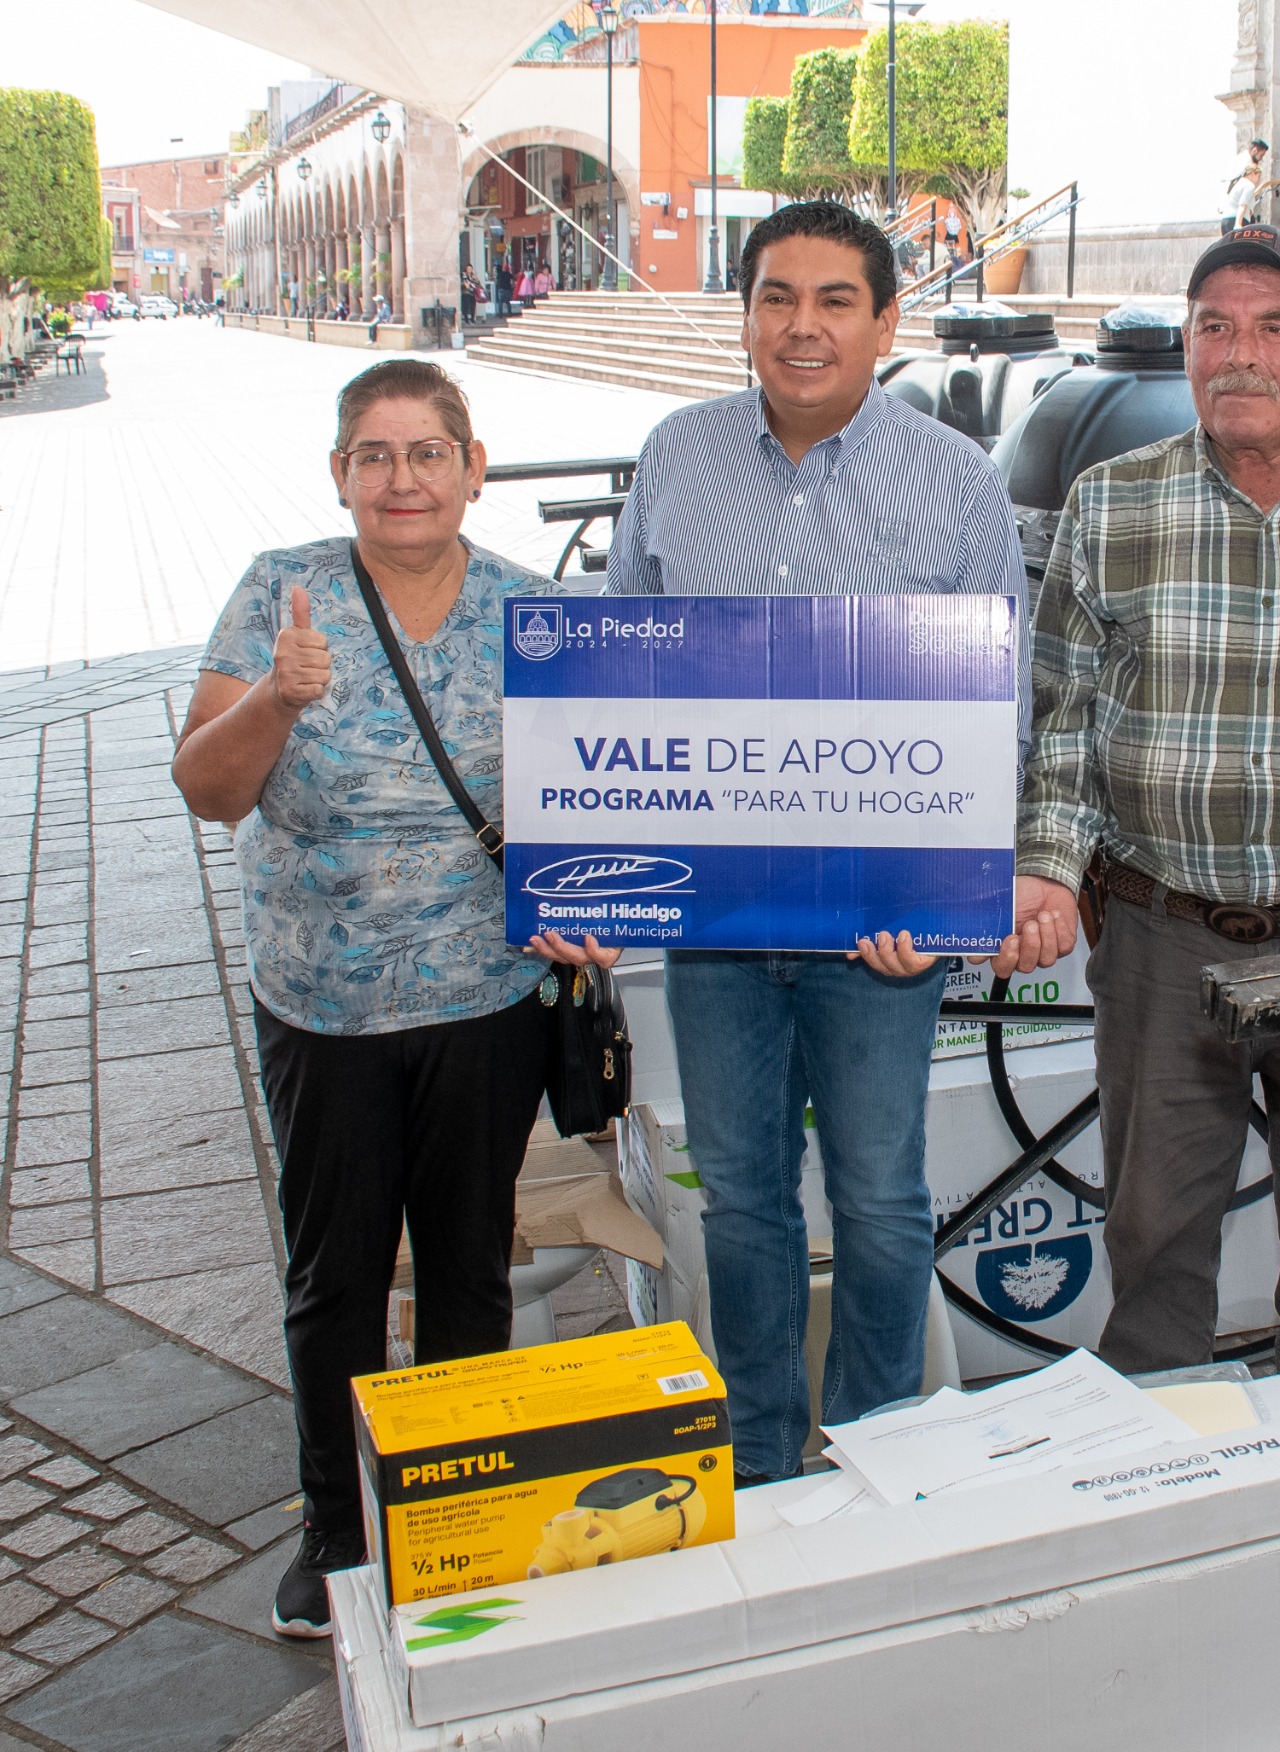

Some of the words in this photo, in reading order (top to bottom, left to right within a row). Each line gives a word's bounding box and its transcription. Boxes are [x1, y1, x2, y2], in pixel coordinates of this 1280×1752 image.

[1233, 230, 1261, 239] FOX
[565, 617, 592, 638] La
[602, 617, 684, 638] Piedad
[565, 640, 607, 649] 2024
[642, 640, 685, 649] 2027
[574, 736, 691, 772] VALE
[707, 738, 766, 773] DE
[779, 738, 944, 776] APOYO
[541, 787, 714, 811] PROGRAMA
[812, 790, 848, 813] TU
[538, 902, 607, 918] Samuel
[611, 903, 682, 922] Hidalgo
[538, 923, 611, 936] Presidente
[615, 924, 683, 940] Municipal
[371, 1369, 454, 1388] PRETUL
[695, 1415, 716, 1425] 27019
[402, 1451, 515, 1487] PRETUL
[1154, 1467, 1222, 1488] Modelo:
[406, 1506, 440, 1519] Bomba
[442, 1496, 489, 1513] periférica
[491, 1492, 513, 1505] para
[514, 1488, 538, 1500] agua
[407, 1519, 420, 1528] de
[421, 1516, 439, 1525] uso
[441, 1508, 481, 1523] agrícola
[407, 1523, 453, 1538] Peripheral
[454, 1518, 479, 1530] water
[480, 1513, 506, 1526] pump
[408, 1537, 421, 1547] for
[423, 1528, 472, 1545] agricultural
[473, 1525, 490, 1534] use
[439, 1553, 471, 1572] Hp
[413, 1587, 426, 1597] 30
[427, 1582, 457, 1594] L/min
[471, 1575, 483, 1585] 20
[485, 1574, 494, 1582] m
